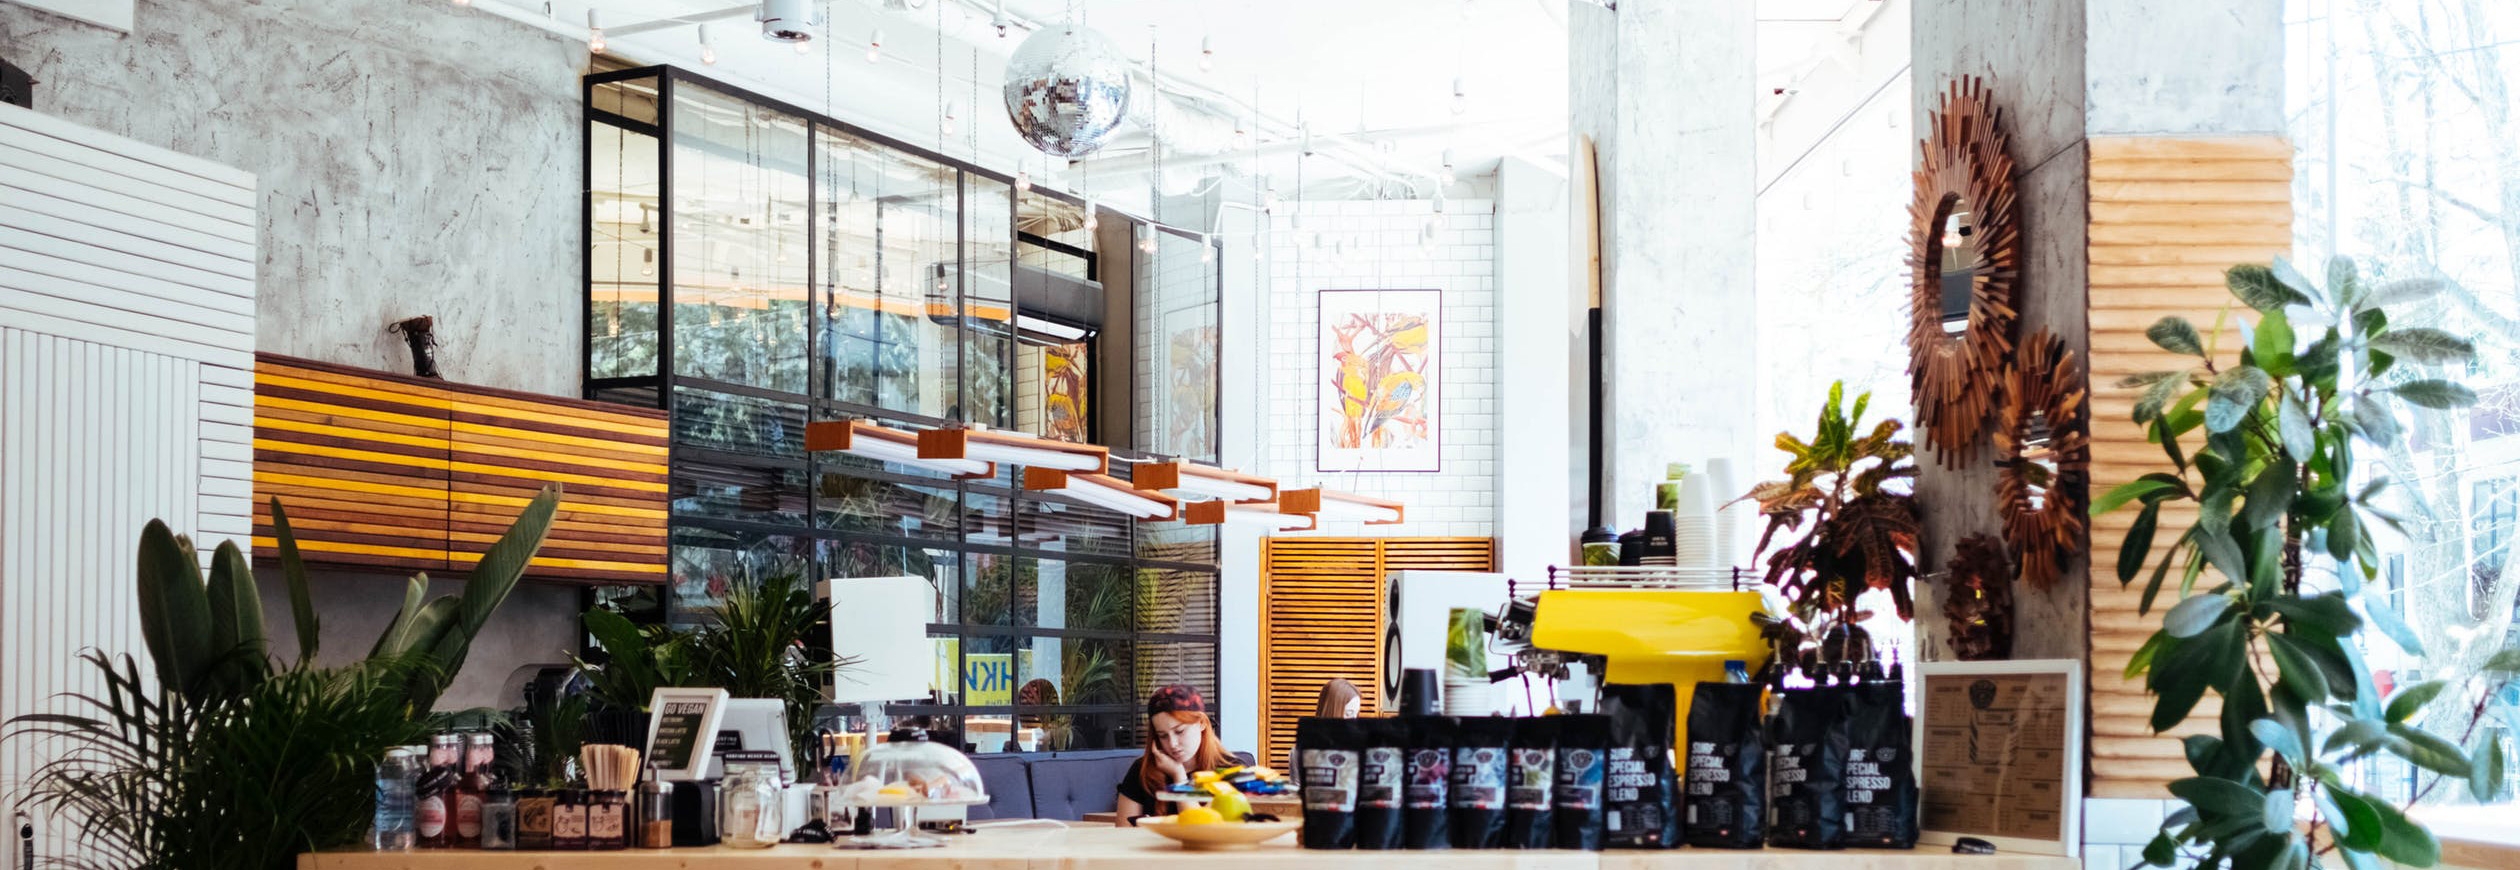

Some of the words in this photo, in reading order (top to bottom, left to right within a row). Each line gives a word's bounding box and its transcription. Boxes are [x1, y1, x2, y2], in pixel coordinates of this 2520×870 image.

[664, 703, 677, 714] GO
[677, 703, 705, 714] VEGAN
[1610, 748, 1634, 760] SURF
[1692, 742, 1716, 754] SURF
[1609, 761, 1646, 773] SPECIAL
[1690, 754, 1724, 768] SPECIAL
[1689, 768, 1730, 782] ESPRESSO
[1846, 762, 1881, 775] PECIAL
[1608, 772, 1656, 787] ESPRESSO
[1846, 776, 1891, 790] SPRESSO
[1608, 788, 1639, 801] BLEND
[1847, 790, 1874, 803] LEND
